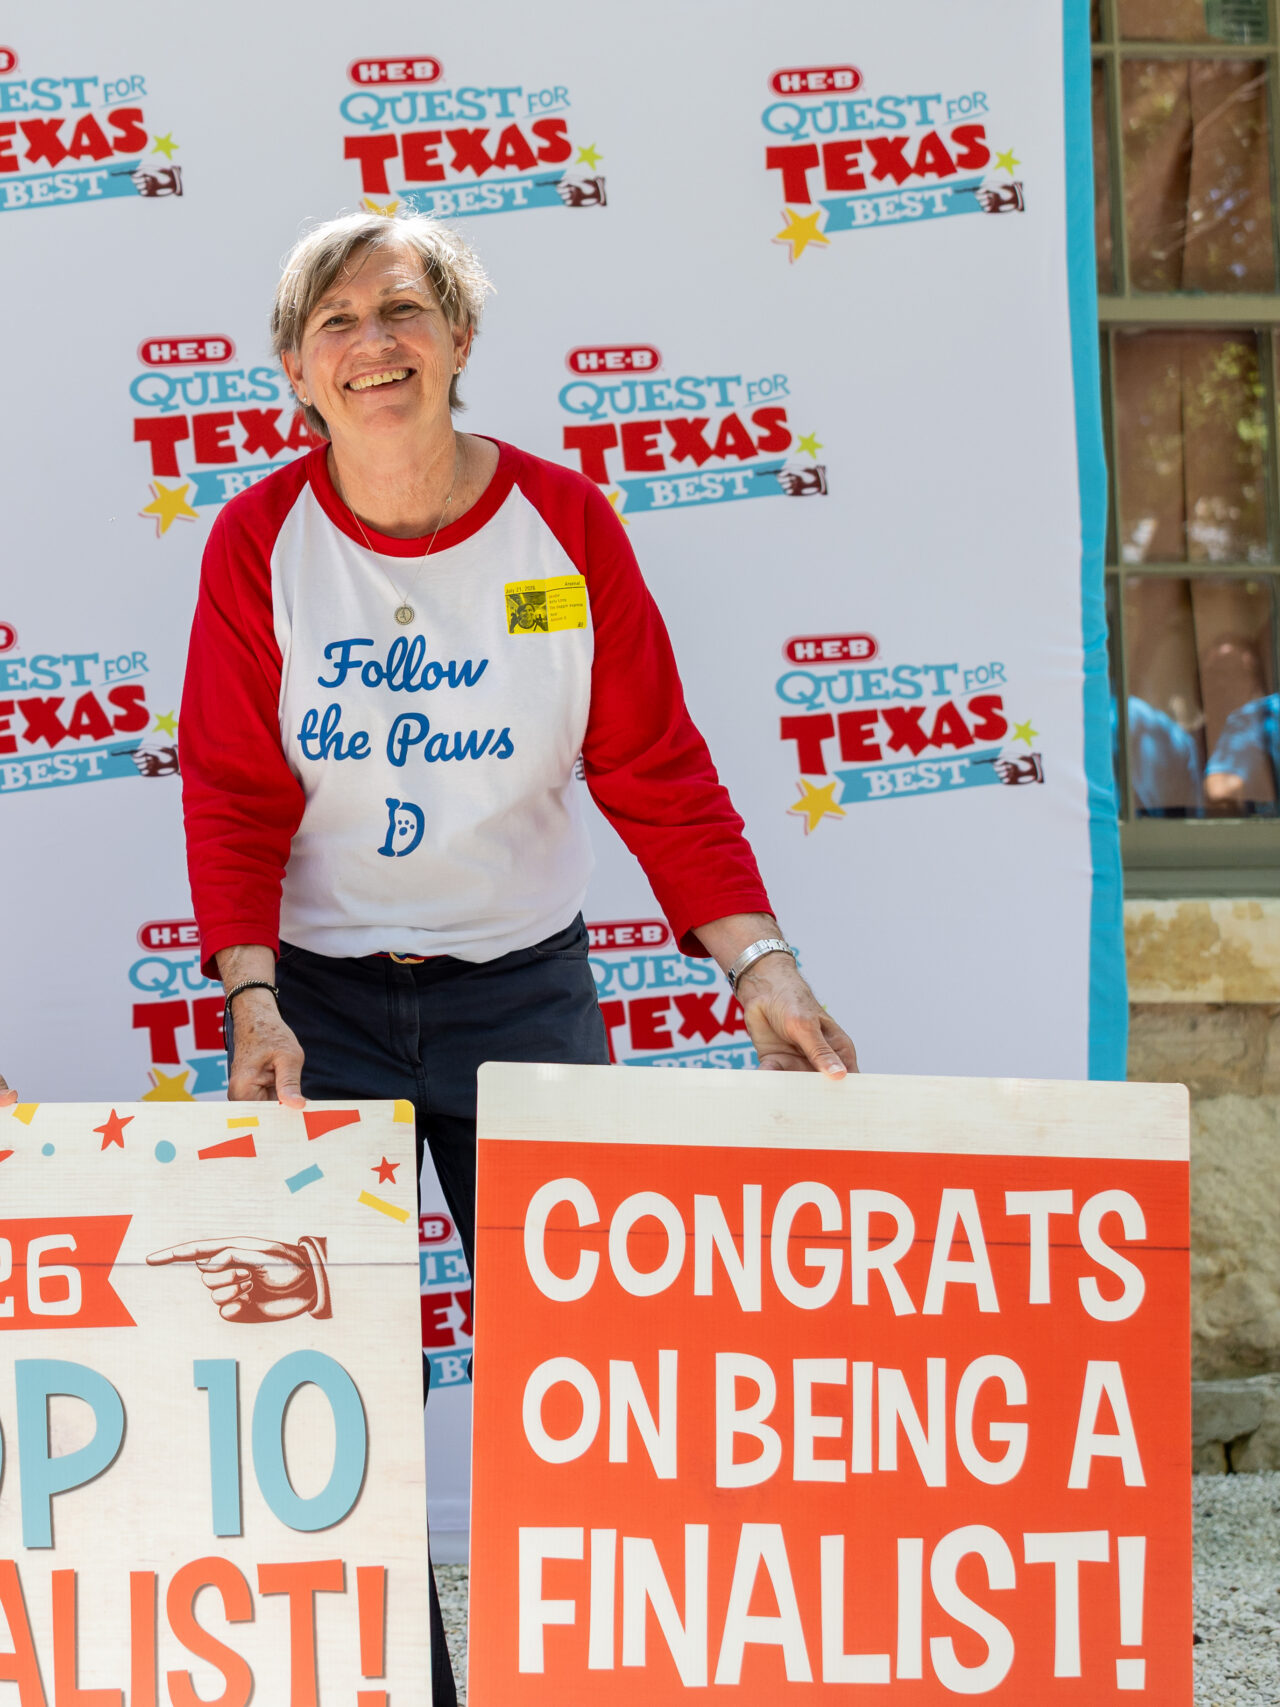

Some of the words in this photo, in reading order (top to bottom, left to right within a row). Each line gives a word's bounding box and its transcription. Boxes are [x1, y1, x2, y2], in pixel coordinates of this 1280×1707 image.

[104, 75, 147, 102] FOR
[340, 86, 522, 131] QUEST
[527, 86, 570, 112] FOR
[762, 93, 942, 141] QUEST
[947, 91, 989, 120] FOR
[344, 119, 572, 194] TEXAS
[766, 124, 990, 204] TEXAS
[0, 170, 108, 208] BEST
[425, 182, 533, 217] BEST
[847, 187, 953, 226] BEST
[129, 367, 282, 413] QUES
[558, 375, 742, 421] QUEST
[747, 374, 790, 402] FOR
[134, 409, 330, 477] TEXA
[563, 408, 792, 485] TEXAS
[646, 470, 754, 507] BEST
[104, 651, 149, 680] FOR
[317, 634, 489, 692] Follow
[776, 663, 959, 712] QUEST
[964, 662, 1008, 690] FOR
[297, 703, 371, 760] the
[386, 712, 514, 767] Paws
[780, 695, 1008, 776] TEXAS
[863, 758, 970, 797] BEST
[523, 1177, 1148, 1322] CONGRATS
[193, 1349, 369, 1538] 10
[522, 1349, 679, 1480] ON
[715, 1352, 1029, 1488] BEING
[1067, 1360, 1147, 1490] A
[518, 1523, 1148, 1695] FINALIST!
